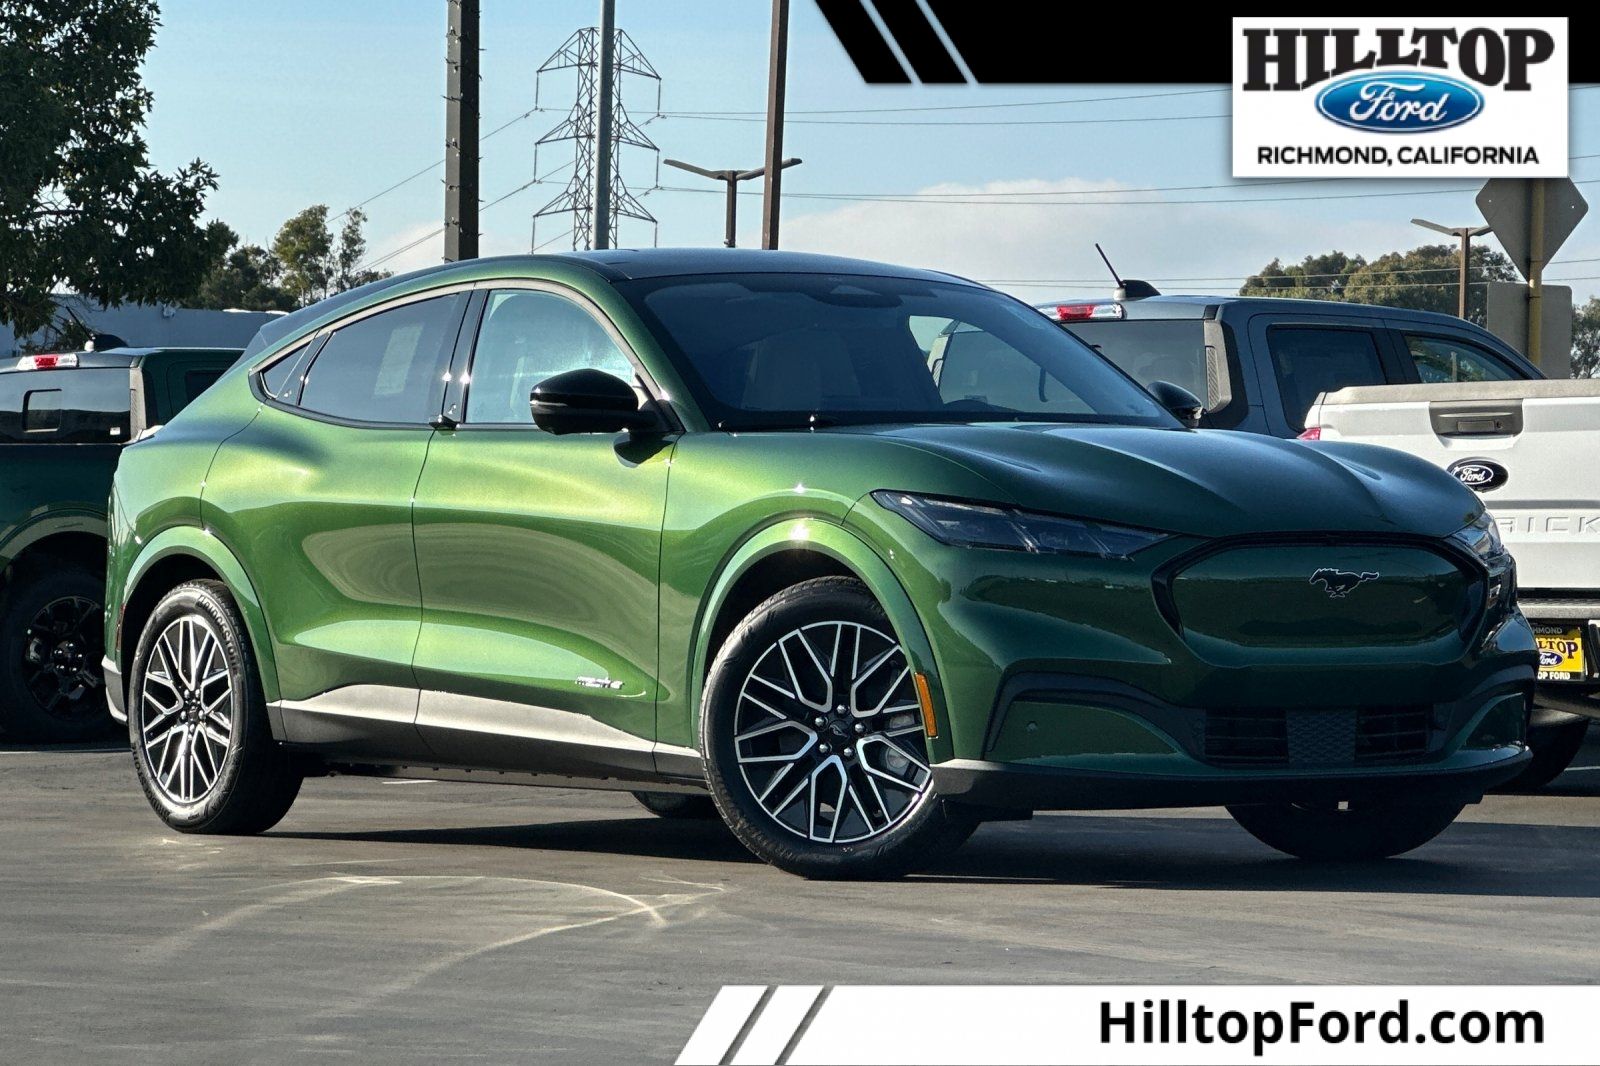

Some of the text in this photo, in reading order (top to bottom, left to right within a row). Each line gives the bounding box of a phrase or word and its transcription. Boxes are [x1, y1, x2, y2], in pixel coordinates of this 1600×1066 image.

[1460, 467, 1485, 482] Ford
[1495, 517, 1600, 533] RICK
[1533, 626, 1562, 634] HMOND
[1538, 640, 1578, 659] LTOP
[1538, 672, 1571, 680] OP FORD
